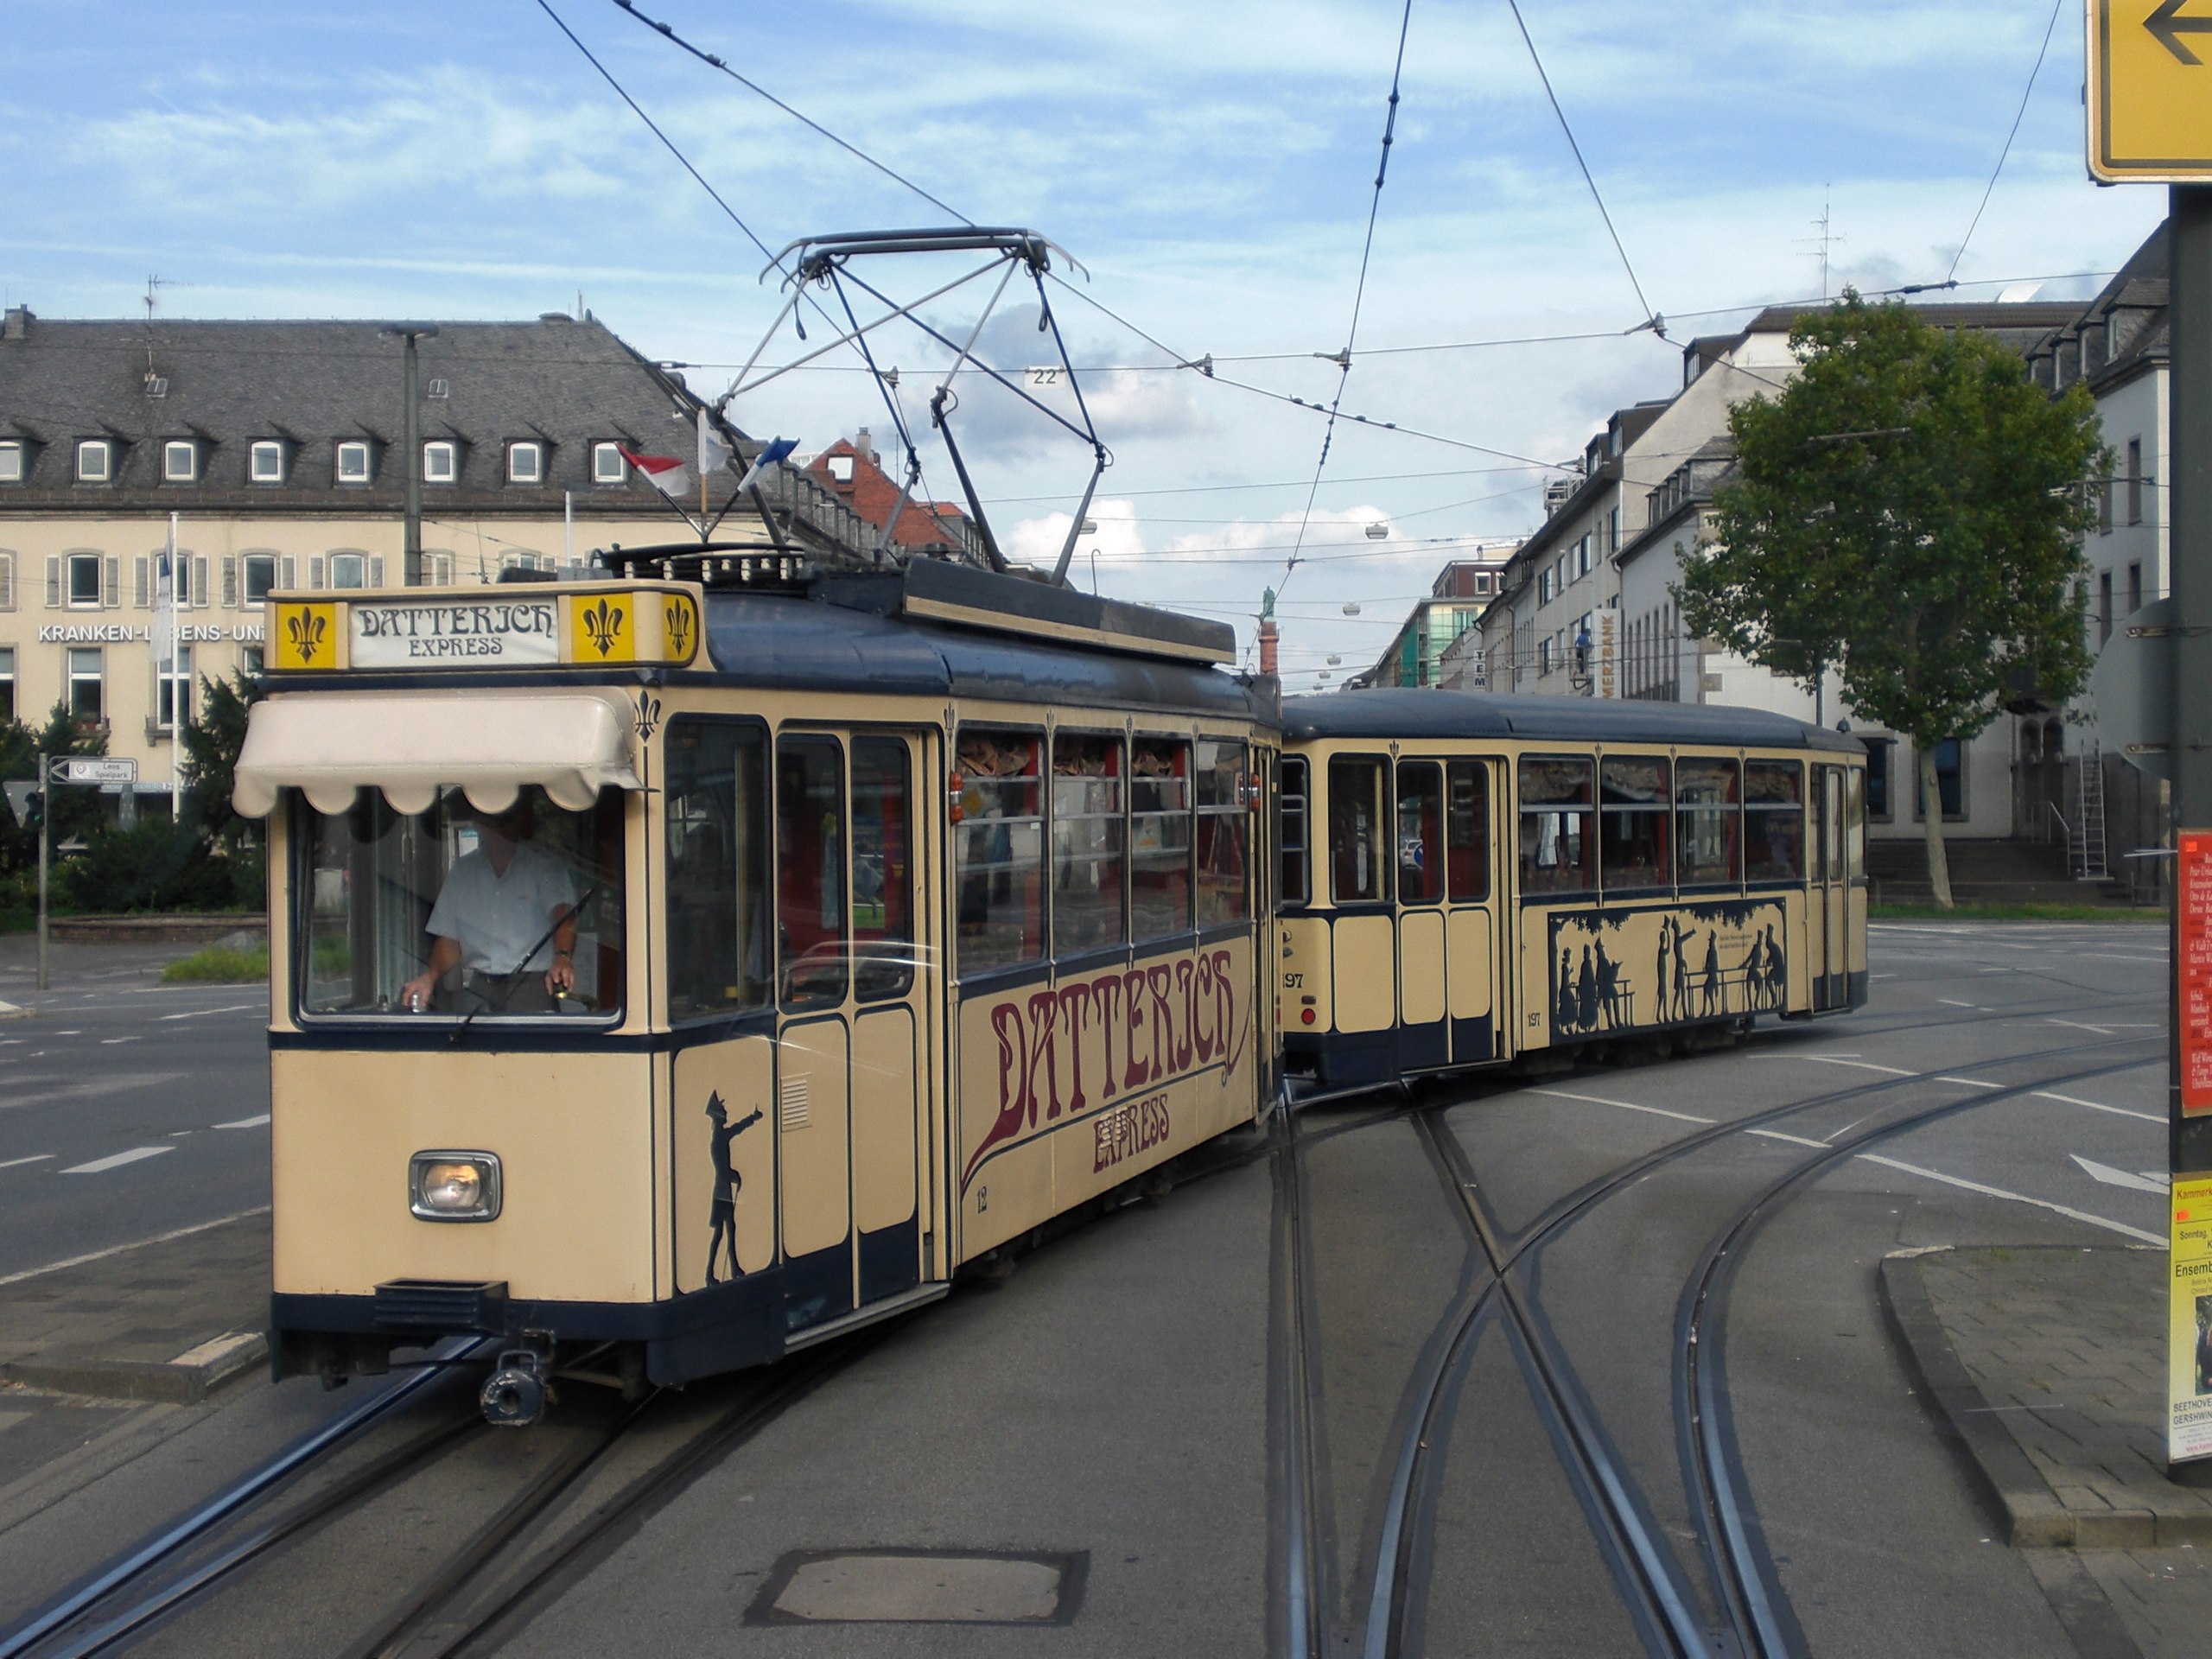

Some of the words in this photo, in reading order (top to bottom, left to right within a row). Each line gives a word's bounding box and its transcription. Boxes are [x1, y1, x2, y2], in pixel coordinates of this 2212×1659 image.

[1033, 368, 1056, 385] 22
[409, 637, 503, 657] EXPRESS
[1283, 973, 1304, 988] 97
[1528, 1012, 1541, 1027] 197
[1093, 1093, 1169, 1174] EXPRESS
[977, 1185, 987, 1214] 12
